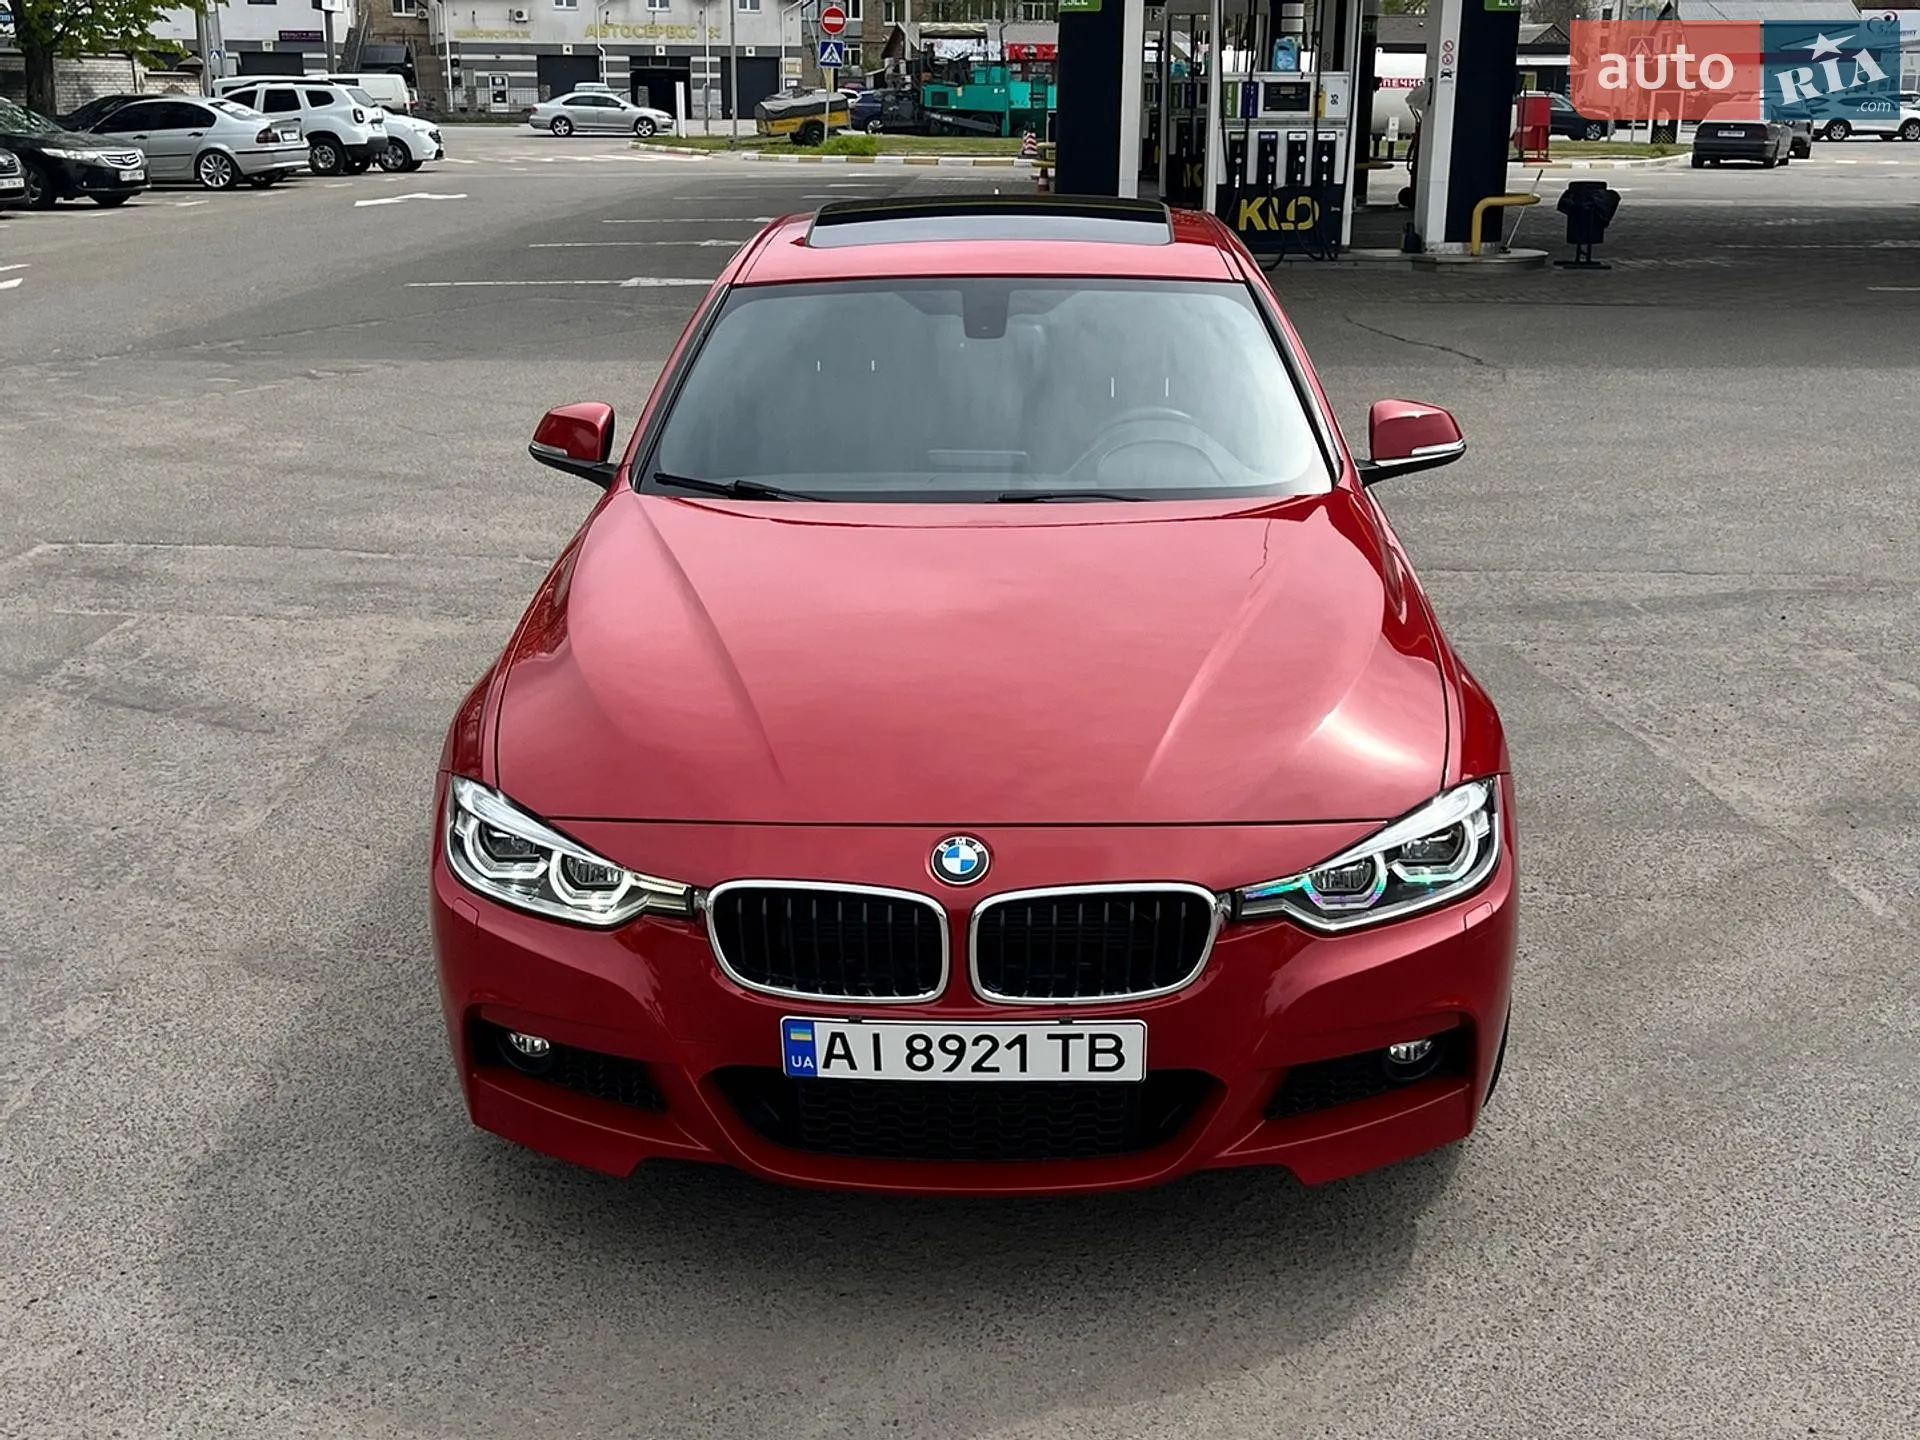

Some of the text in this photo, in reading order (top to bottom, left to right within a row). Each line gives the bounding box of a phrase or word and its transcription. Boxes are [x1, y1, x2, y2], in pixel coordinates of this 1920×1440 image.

[1238, 196, 1320, 231] KLO
[938, 837, 985, 854] BMW
[790, 1055, 814, 1069] UA
[821, 1031, 1126, 1073] AI 8921 TB
